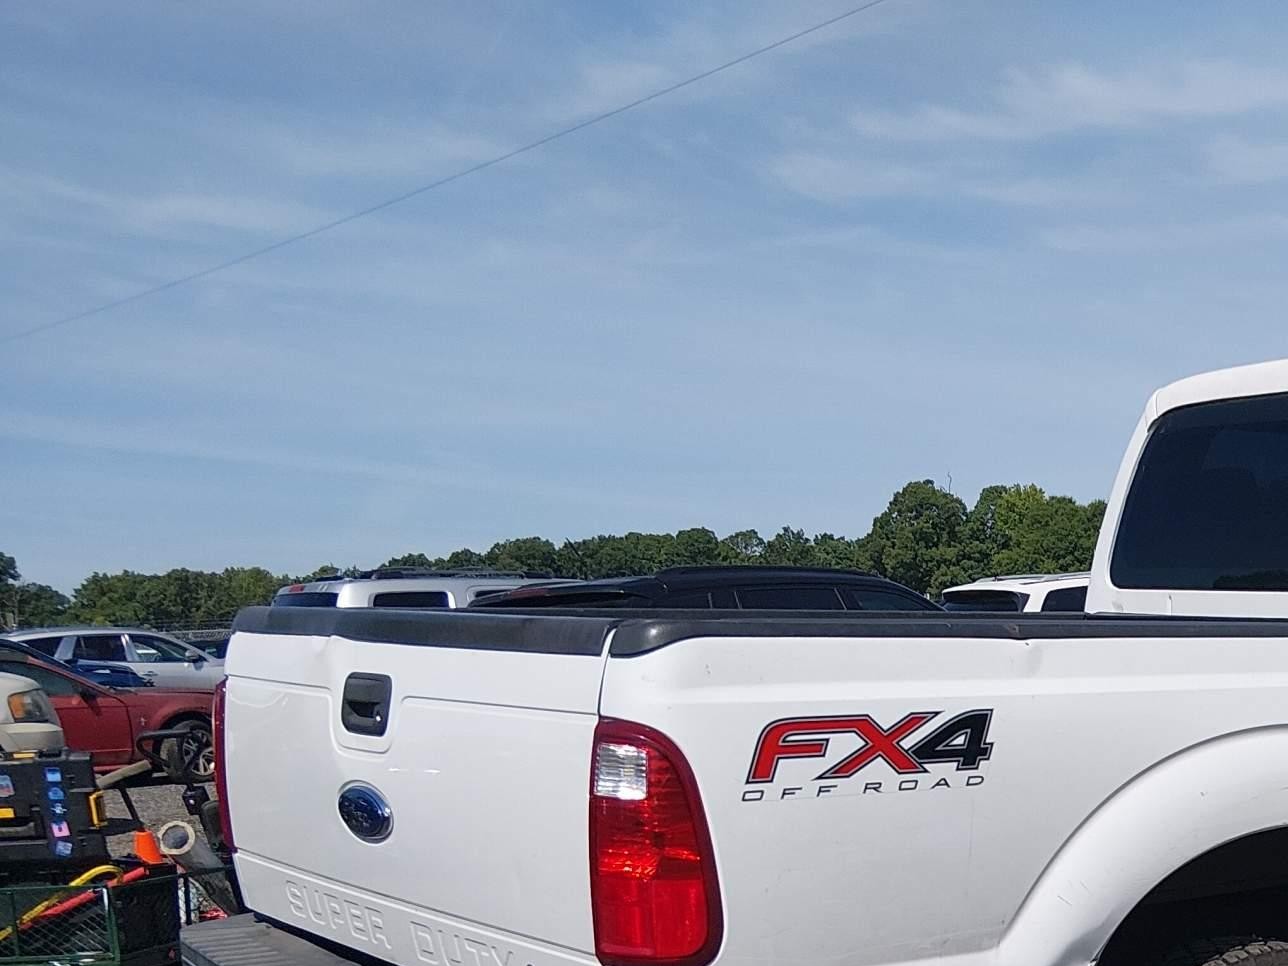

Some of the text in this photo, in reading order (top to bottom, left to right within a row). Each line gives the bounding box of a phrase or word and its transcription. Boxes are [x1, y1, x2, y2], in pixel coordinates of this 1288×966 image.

[745, 708, 995, 785] FX4
[741, 775, 985, 802] OFF ROAD
[286, 880, 392, 950] SUPER
